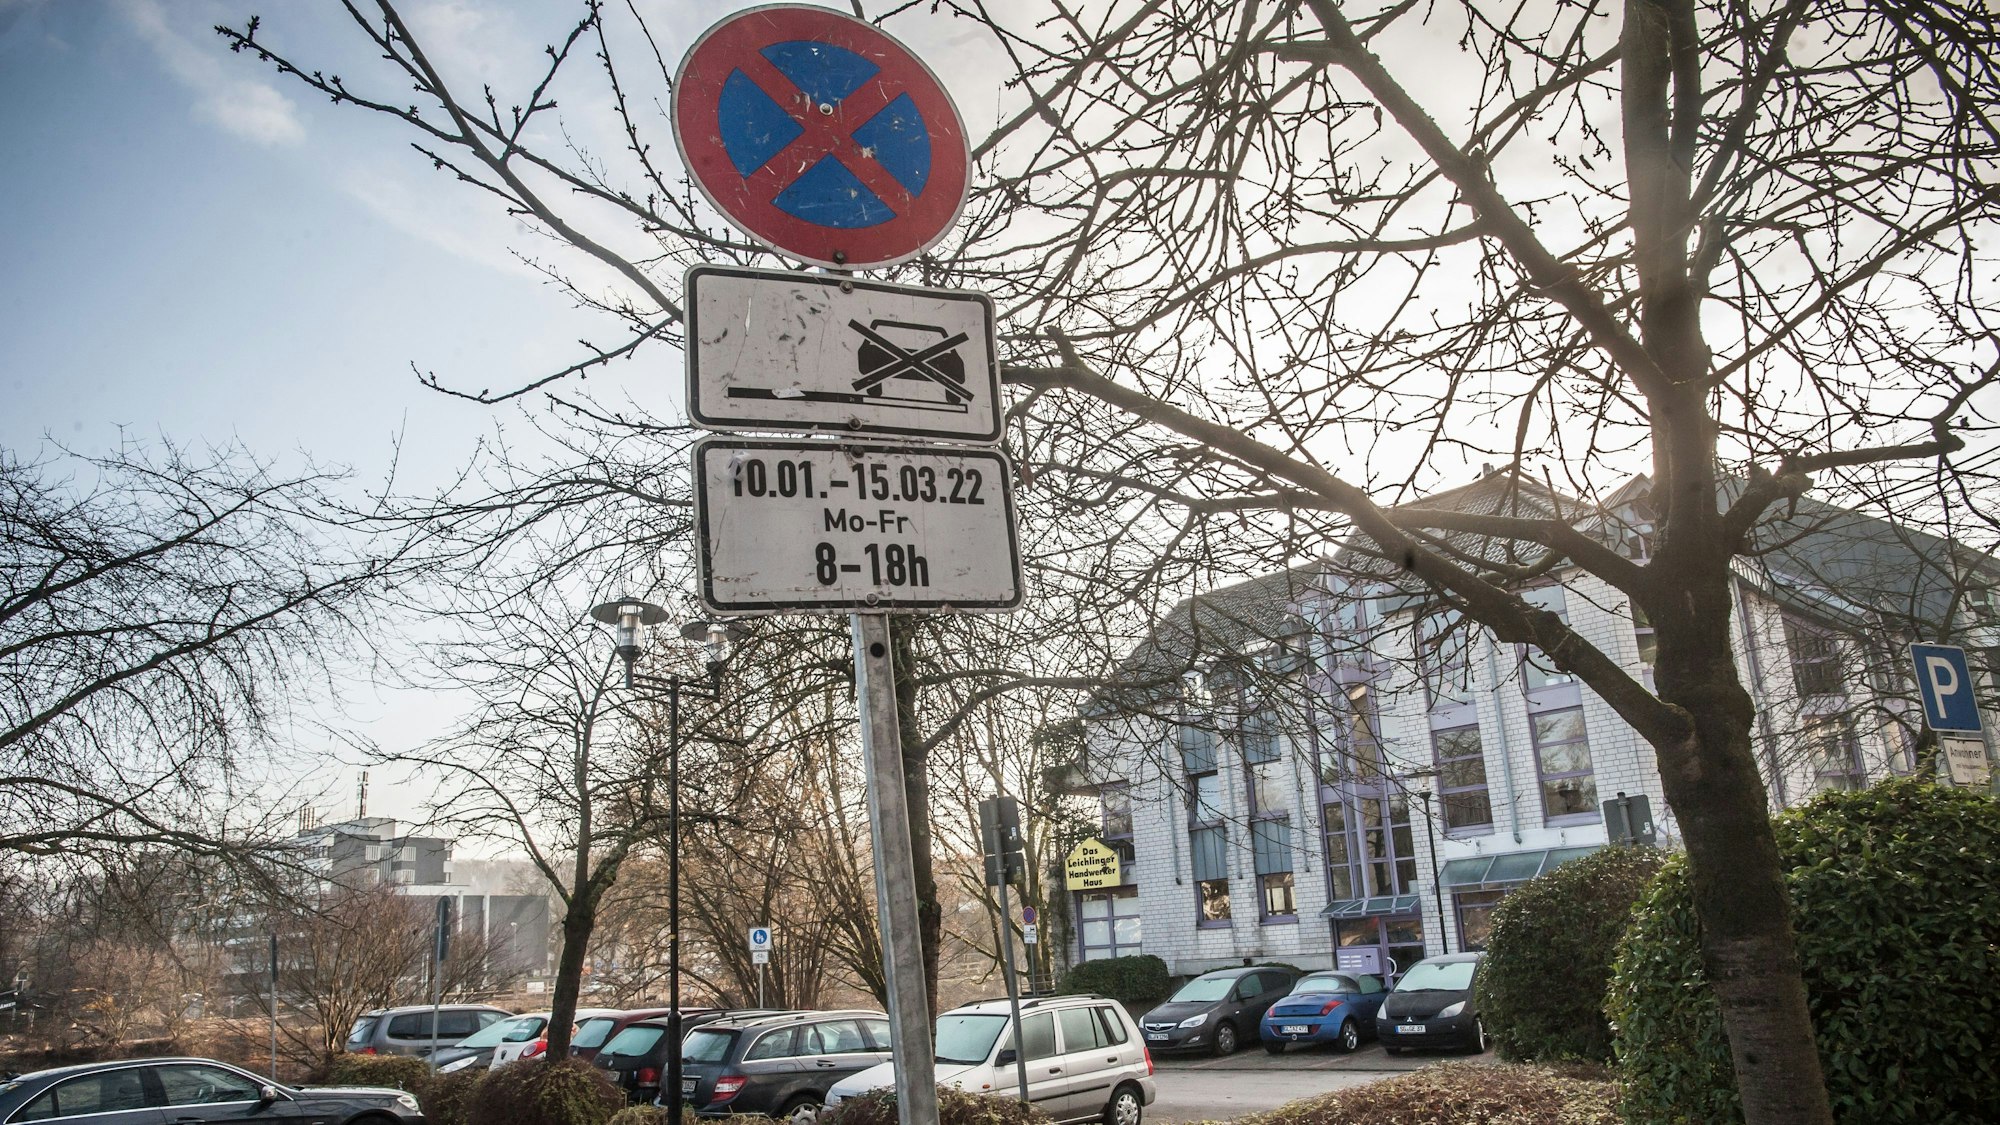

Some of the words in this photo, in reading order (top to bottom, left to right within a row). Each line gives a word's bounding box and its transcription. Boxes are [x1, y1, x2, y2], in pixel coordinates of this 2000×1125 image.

[824, 508, 909, 534] Mo-Fr
[815, 542, 930, 587] 8-18h
[1926, 656, 1958, 719] P
[1082, 848, 1098, 856] Das
[1068, 857, 1115, 868] Leichlinger
[1069, 868, 1116, 879] Handwerker
[1083, 879, 1103, 887] Haus
